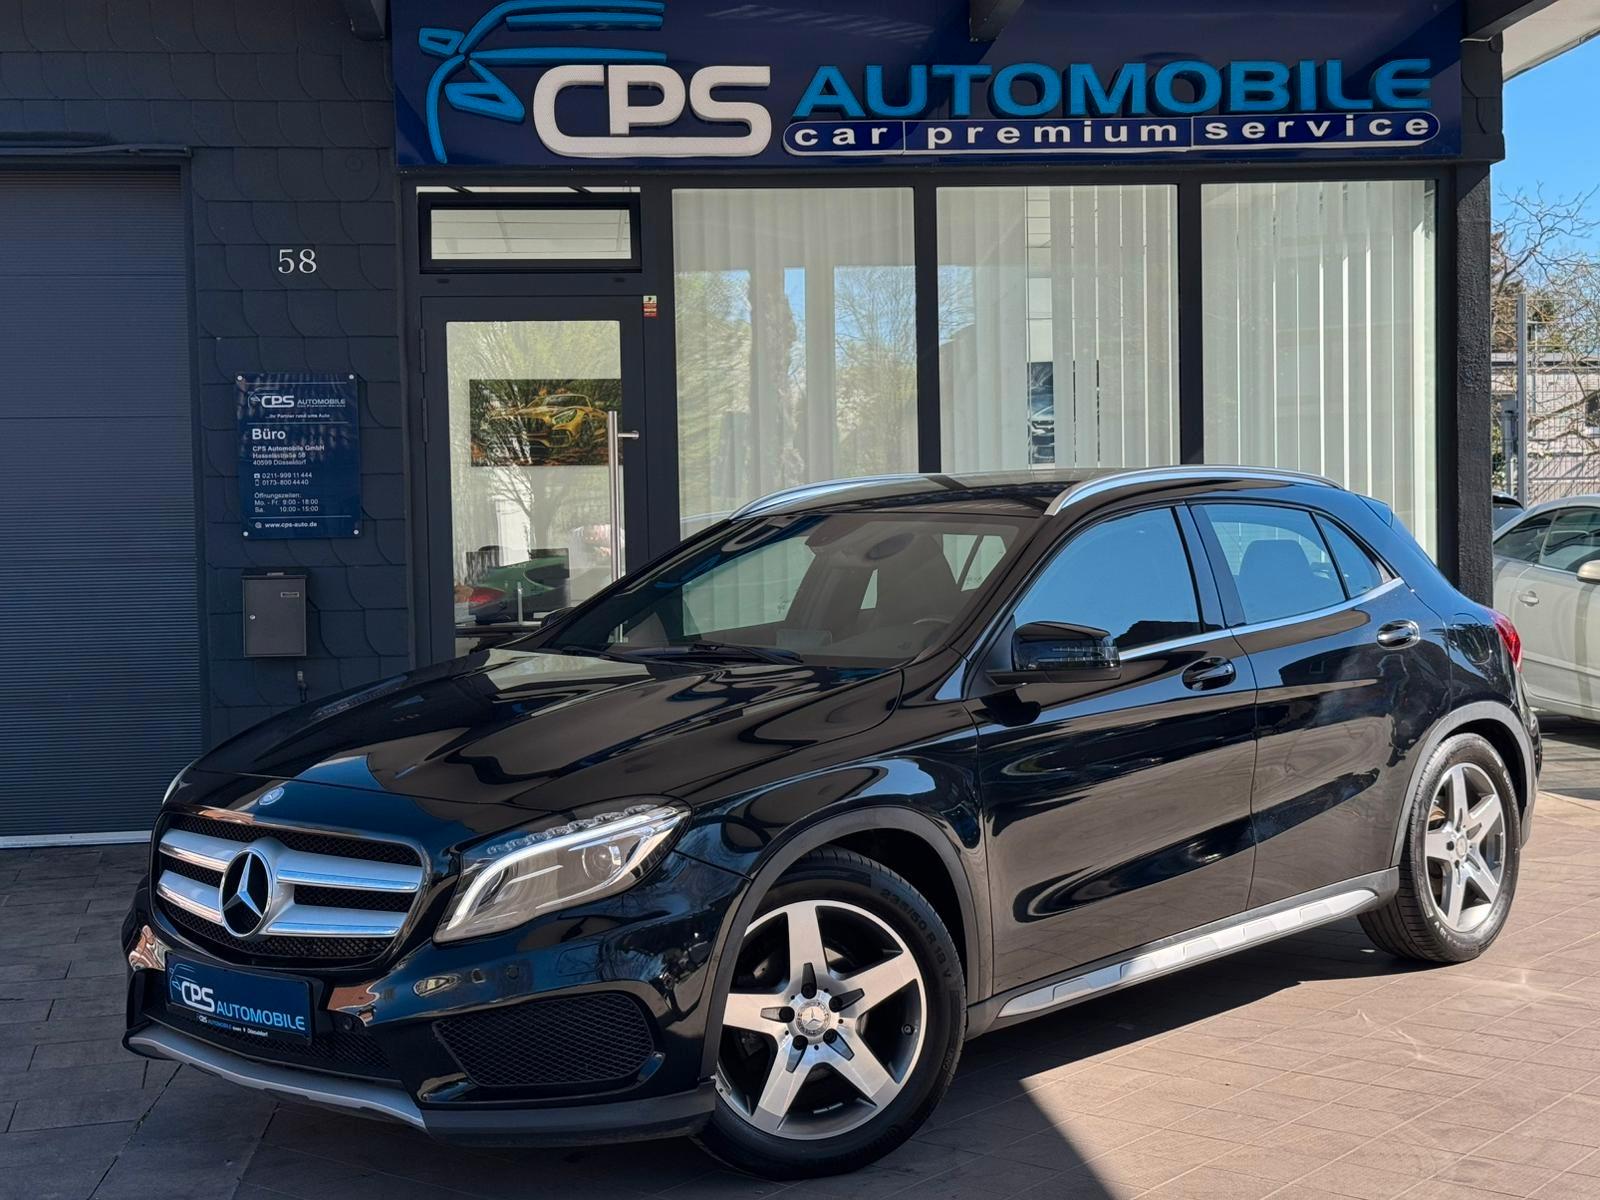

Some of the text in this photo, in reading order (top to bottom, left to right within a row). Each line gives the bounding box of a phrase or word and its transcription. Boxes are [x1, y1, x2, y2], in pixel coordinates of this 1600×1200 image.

[533, 58, 1432, 158] CPS AUTOMOBILE
[794, 114, 1430, 149] car premium service
[278, 248, 317, 274] 58
[261, 395, 295, 408] CPS
[252, 428, 286, 440] Büro
[181, 980, 306, 1031] CPS AUTOMOBILE
